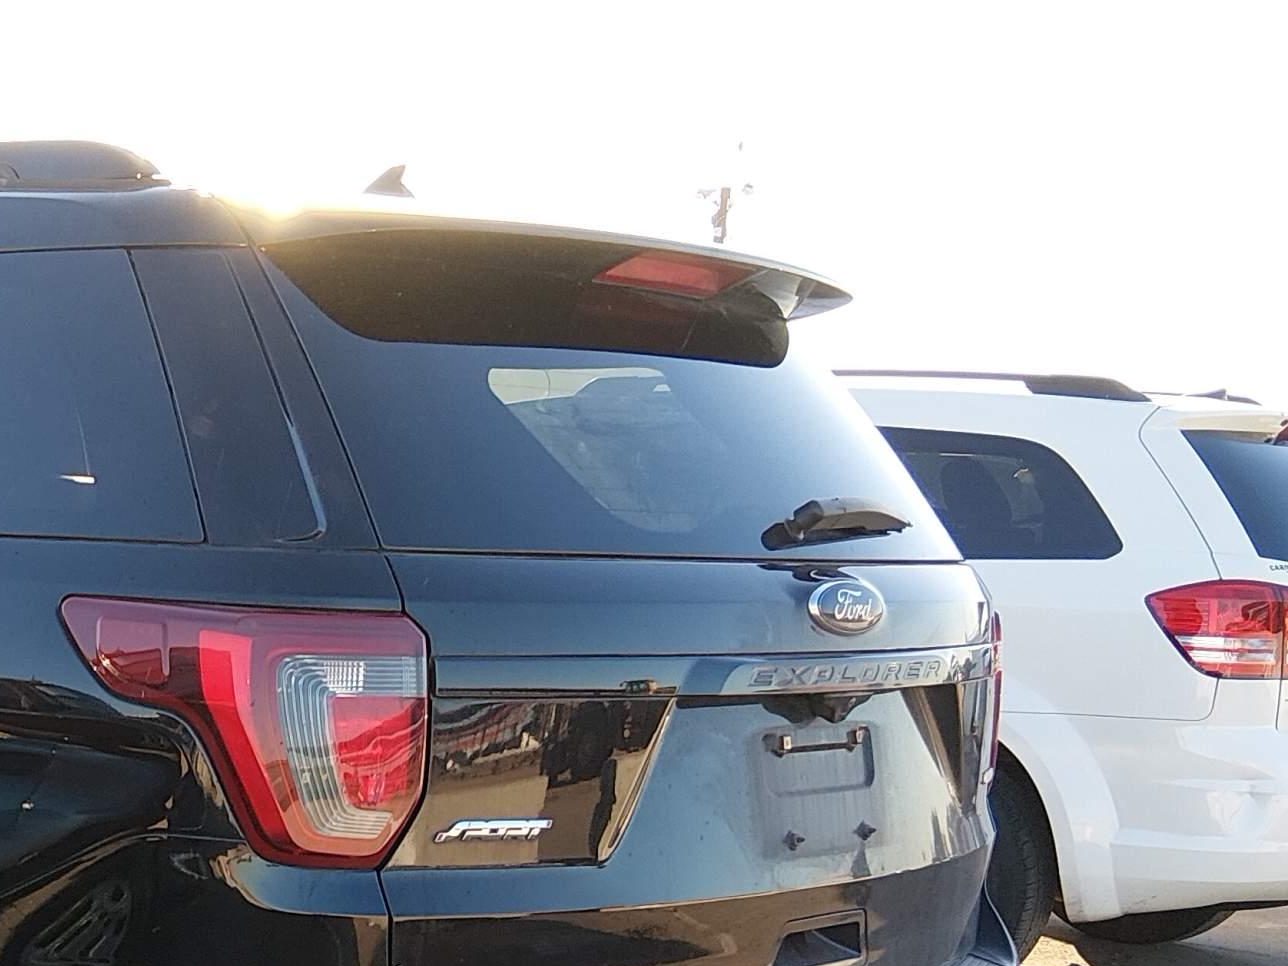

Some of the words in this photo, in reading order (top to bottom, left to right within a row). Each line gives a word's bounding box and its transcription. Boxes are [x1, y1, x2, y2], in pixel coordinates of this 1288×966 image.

[834, 588, 876, 621] Ford
[747, 659, 942, 688] EXPLORER
[433, 819, 553, 844] SPORT
